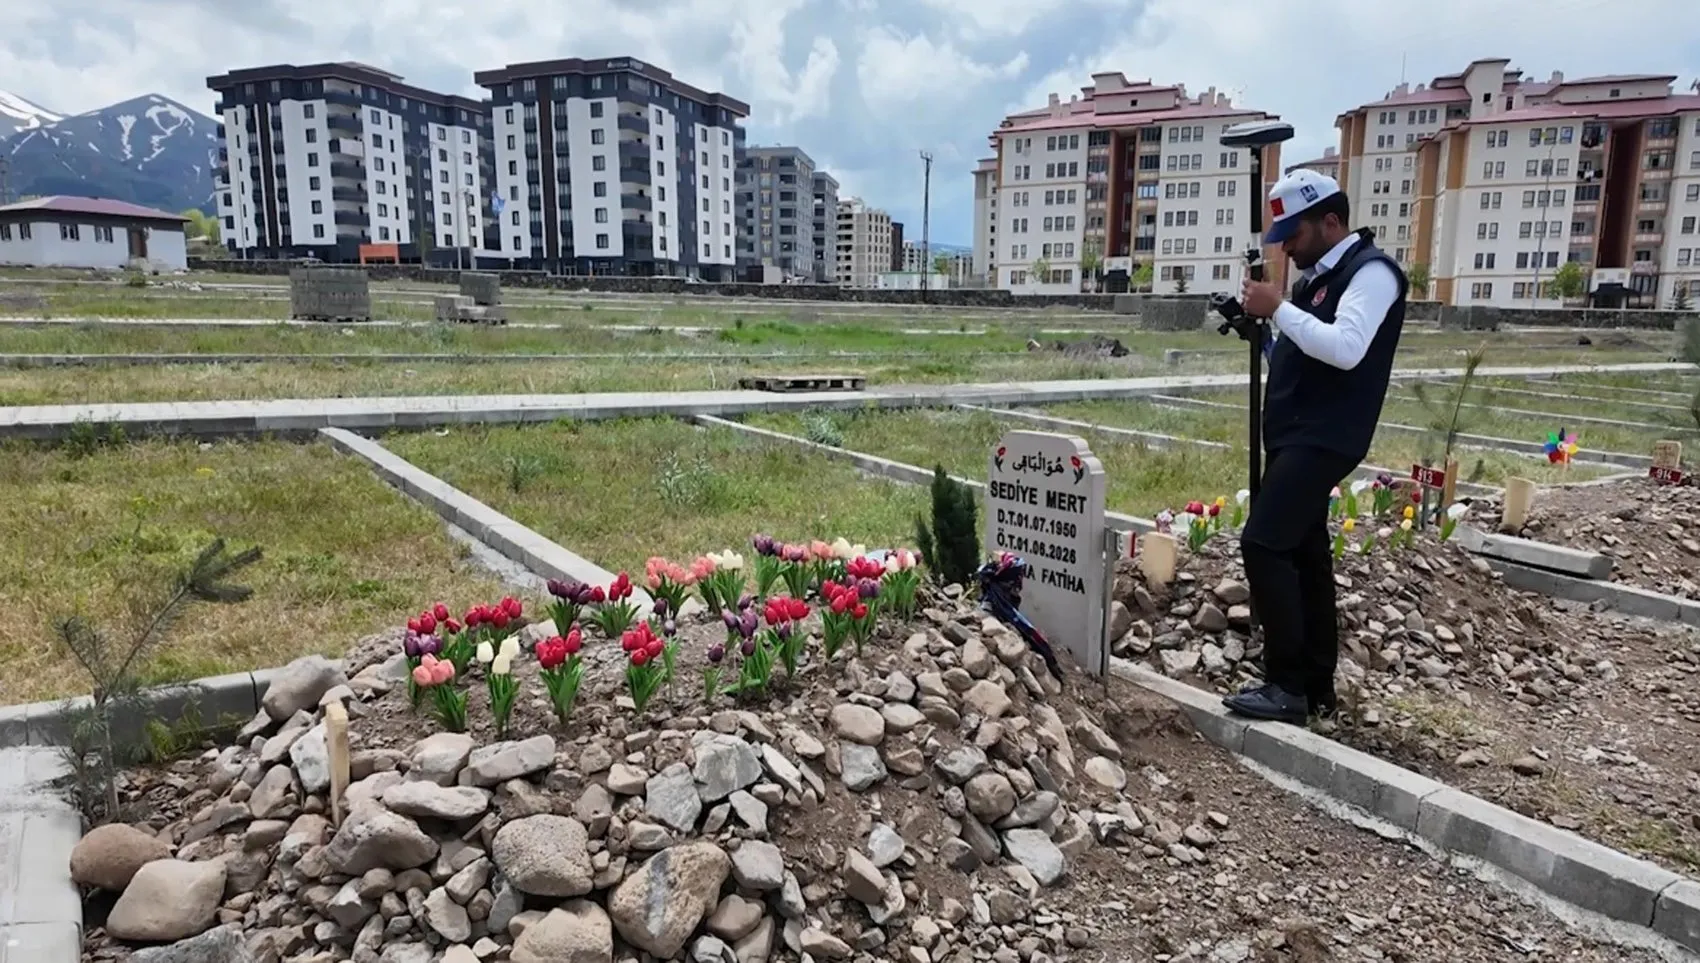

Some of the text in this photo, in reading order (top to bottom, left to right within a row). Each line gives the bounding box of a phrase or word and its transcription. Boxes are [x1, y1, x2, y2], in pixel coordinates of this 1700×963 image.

[990, 479, 1087, 514] SEDİYE MERT
[1041, 568, 1085, 594] FATİHA
